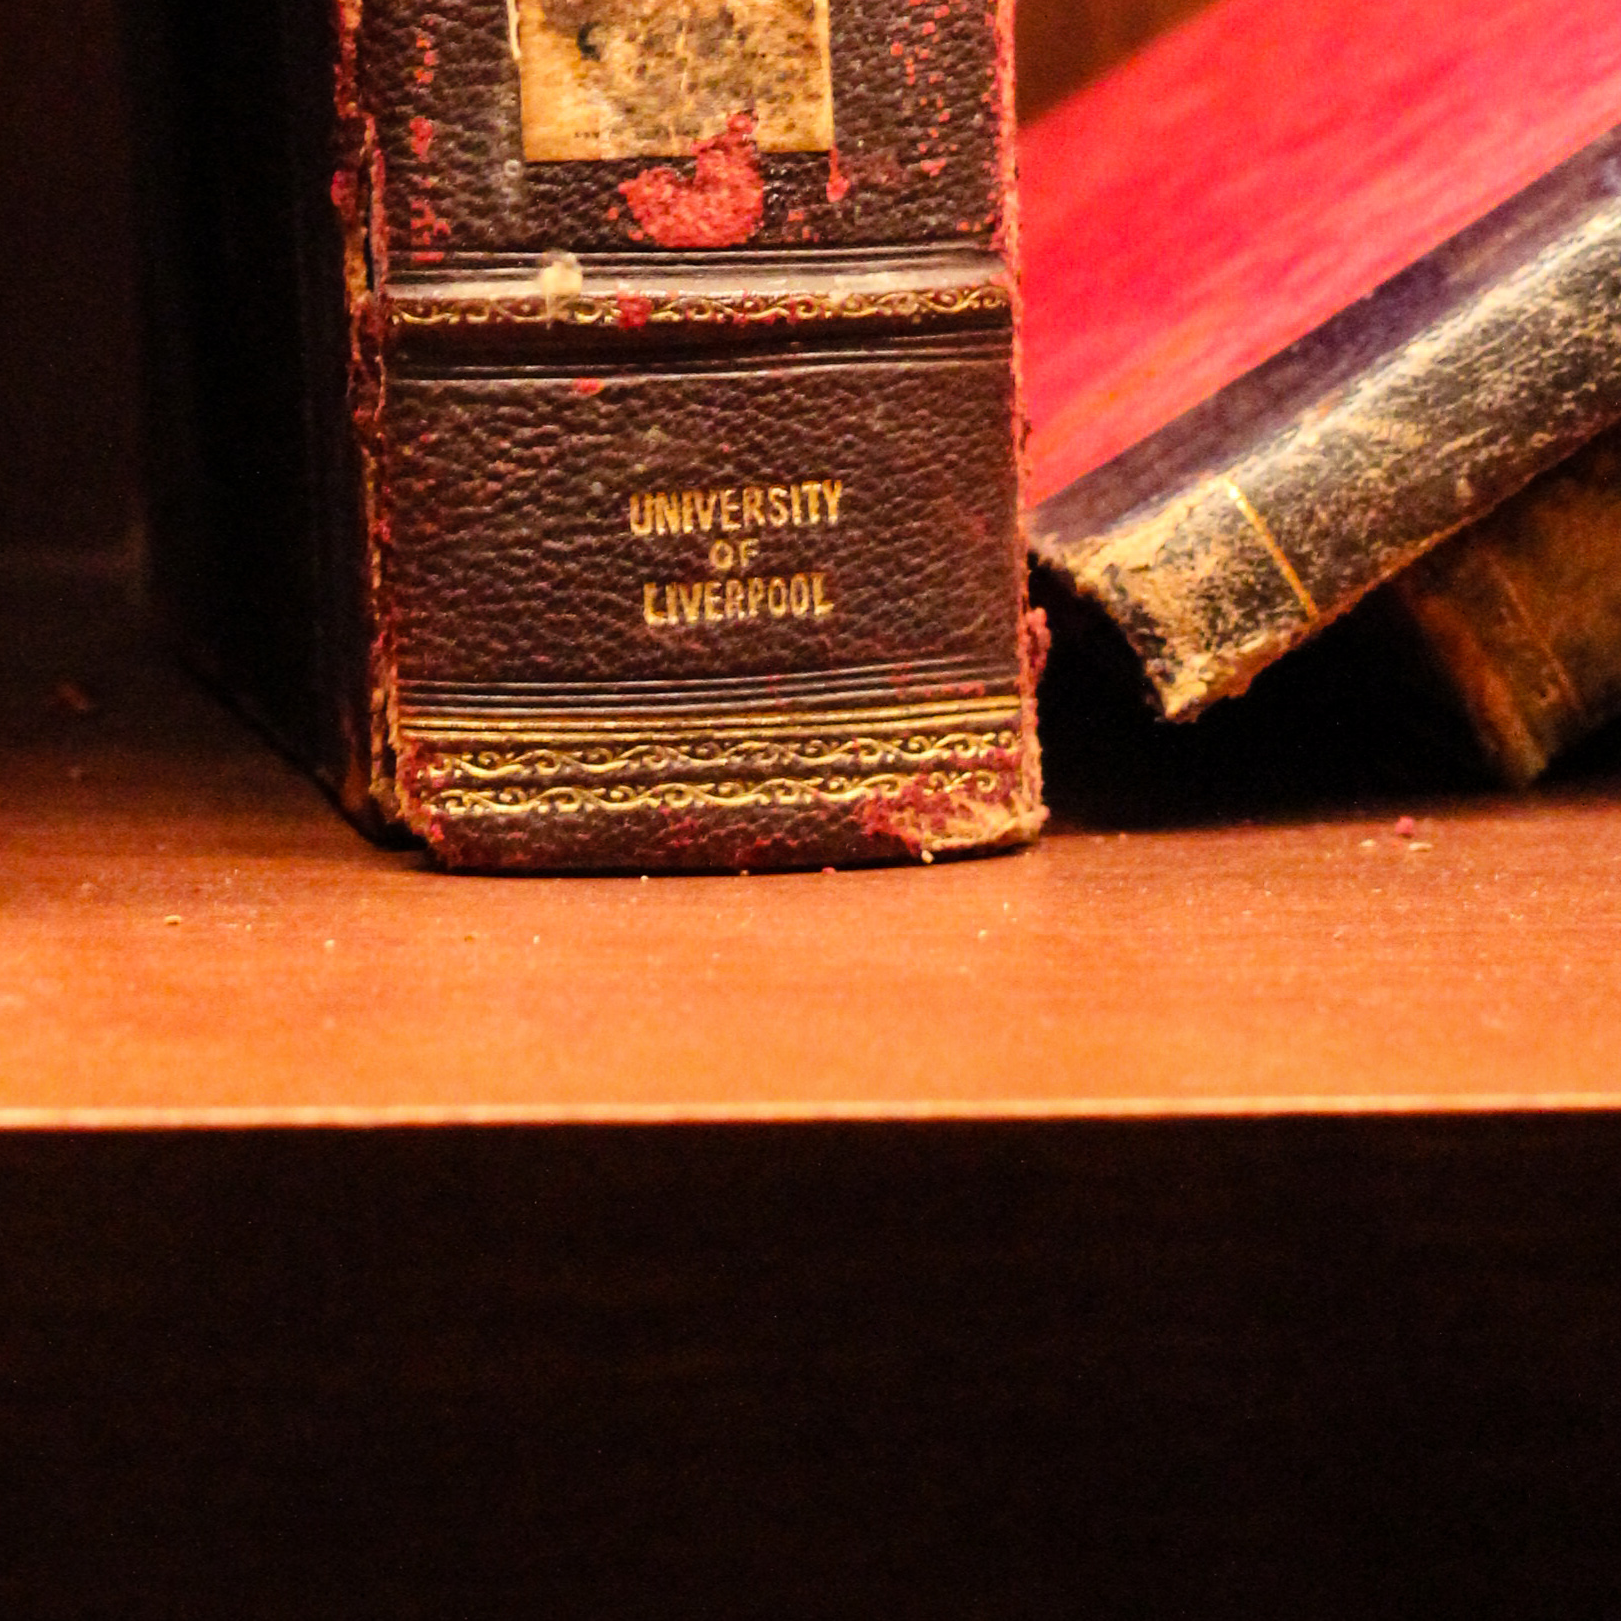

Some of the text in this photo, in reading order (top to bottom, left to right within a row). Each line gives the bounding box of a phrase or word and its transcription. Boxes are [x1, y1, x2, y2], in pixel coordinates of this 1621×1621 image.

[630, 480, 843, 536] UNIVERSITY
[708, 537, 760, 571] OF
[643, 572, 835, 626] LIVERPOOL
